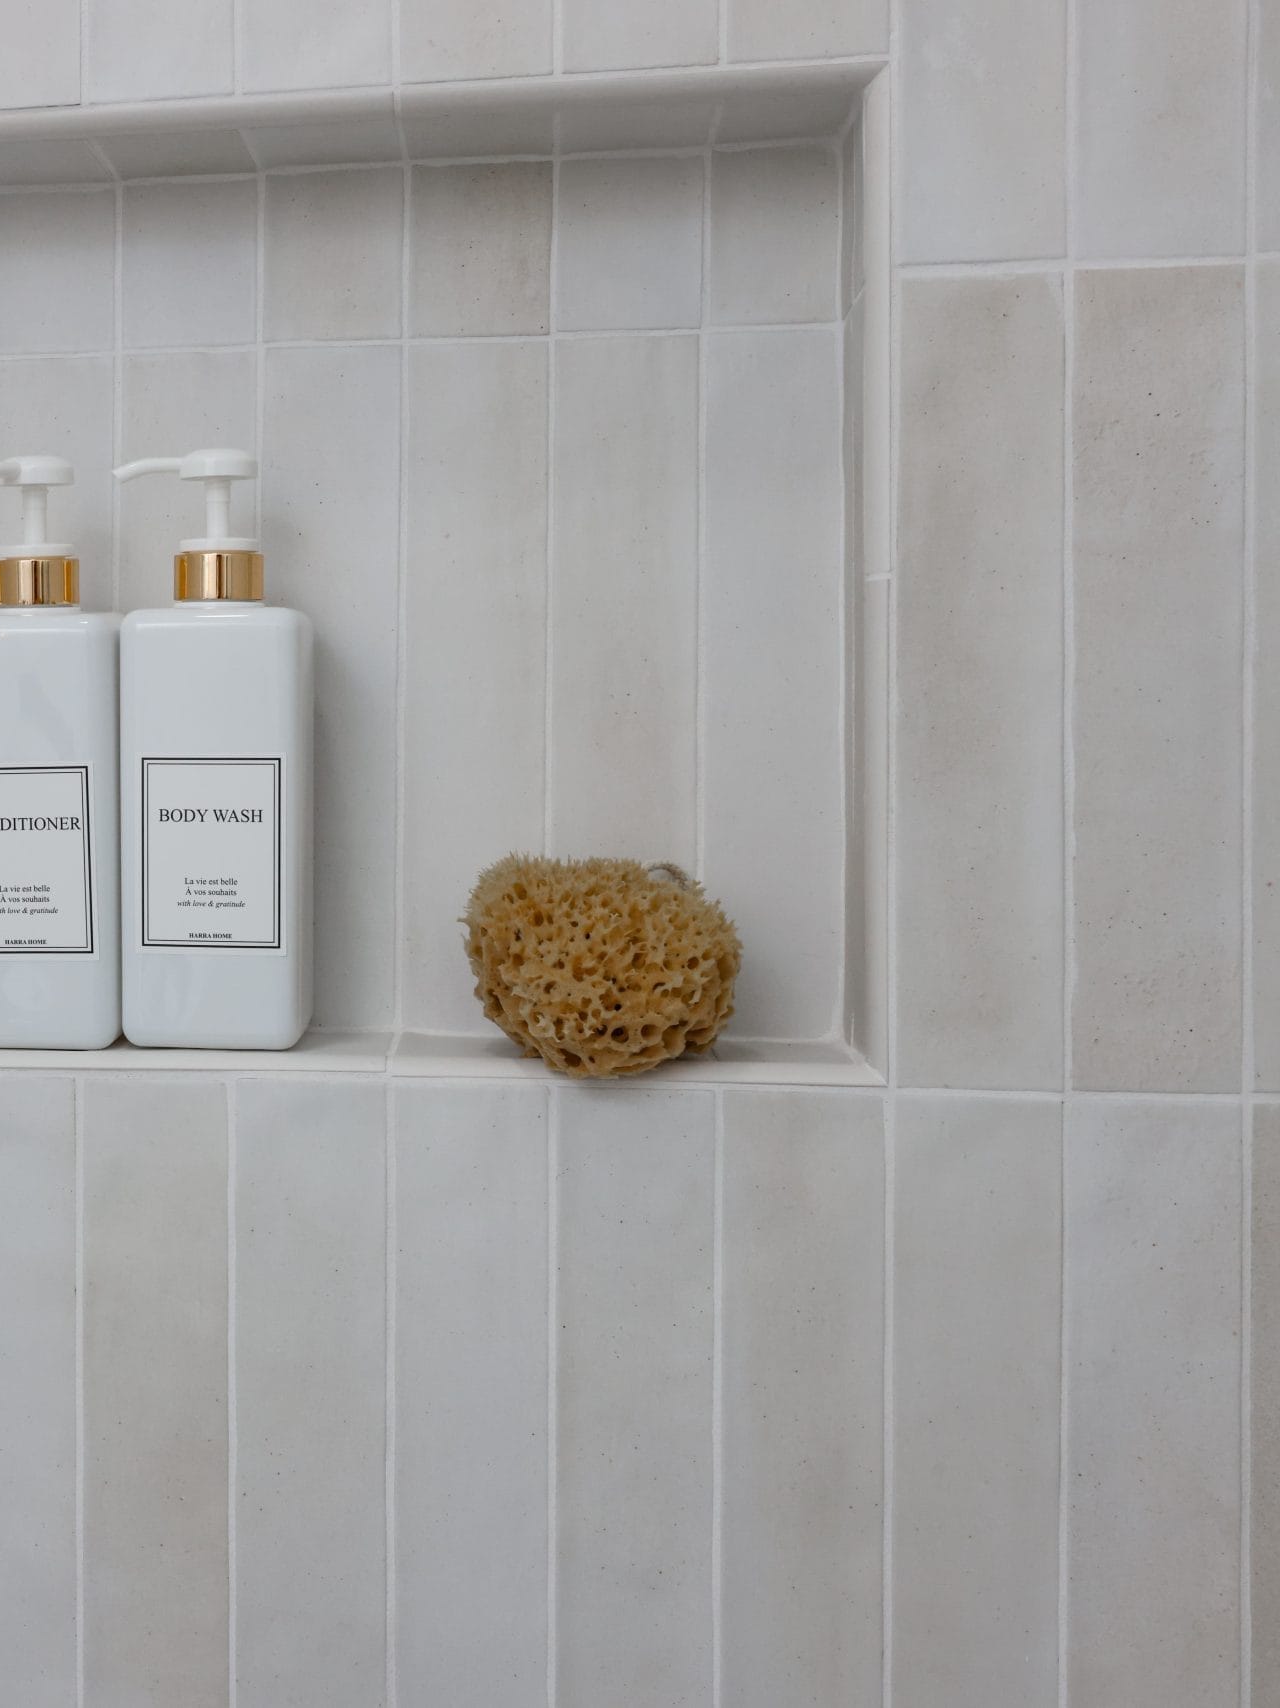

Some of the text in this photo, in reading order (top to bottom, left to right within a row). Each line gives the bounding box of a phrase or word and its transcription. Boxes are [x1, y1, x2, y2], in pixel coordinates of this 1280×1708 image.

[158, 808, 263, 823] BODY WASH
[220, 878, 238, 886] belle
[215, 900, 246, 908] gratitude
[29, 907, 58, 915] gratitude
